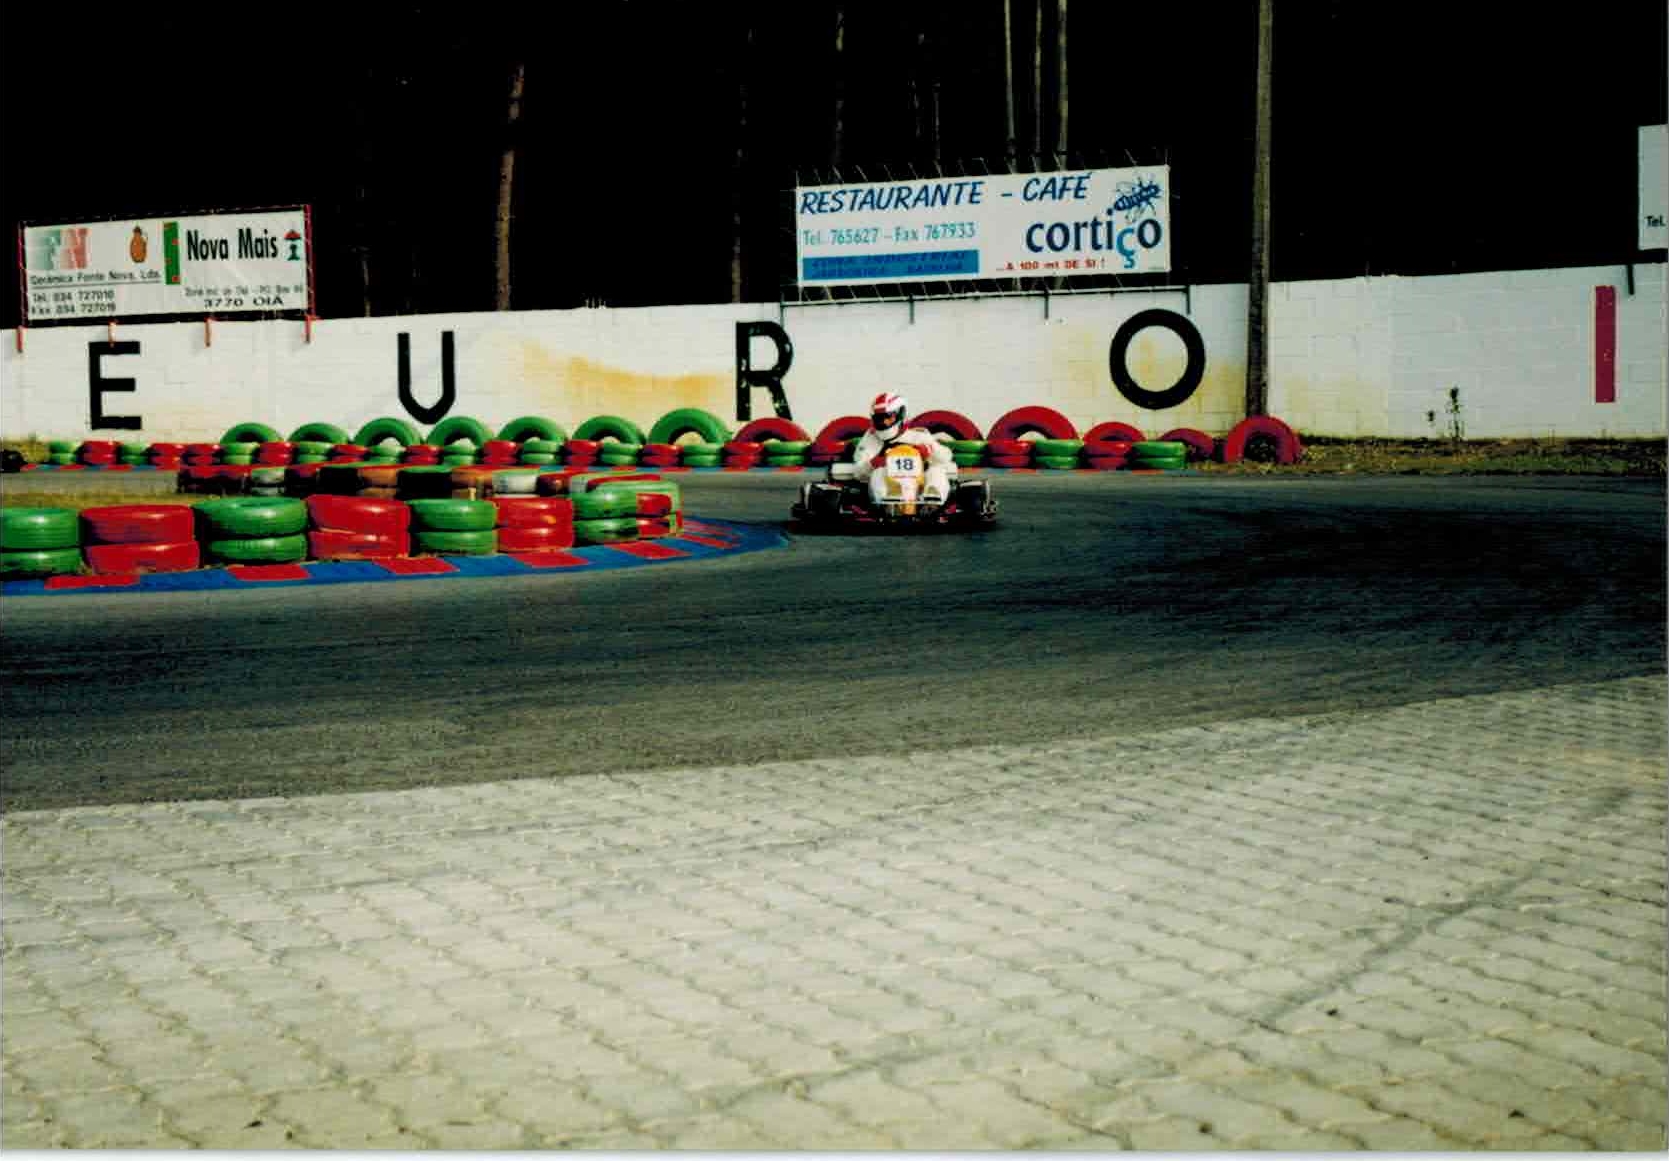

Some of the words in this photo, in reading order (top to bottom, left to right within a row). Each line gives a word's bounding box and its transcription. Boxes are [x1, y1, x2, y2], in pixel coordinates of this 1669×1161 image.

[800, 181, 985, 214] RESTAURANTE
[1022, 171, 1092, 201] CAFÉ
[187, 229, 229, 261] Nova
[238, 227, 279, 260] Mais
[830, 228, 878, 245] 765627
[894, 227, 918, 242] Fax
[924, 222, 975, 240] 767933
[1026, 208, 1162, 269] cortiço
[895, 458, 914, 471] 18
